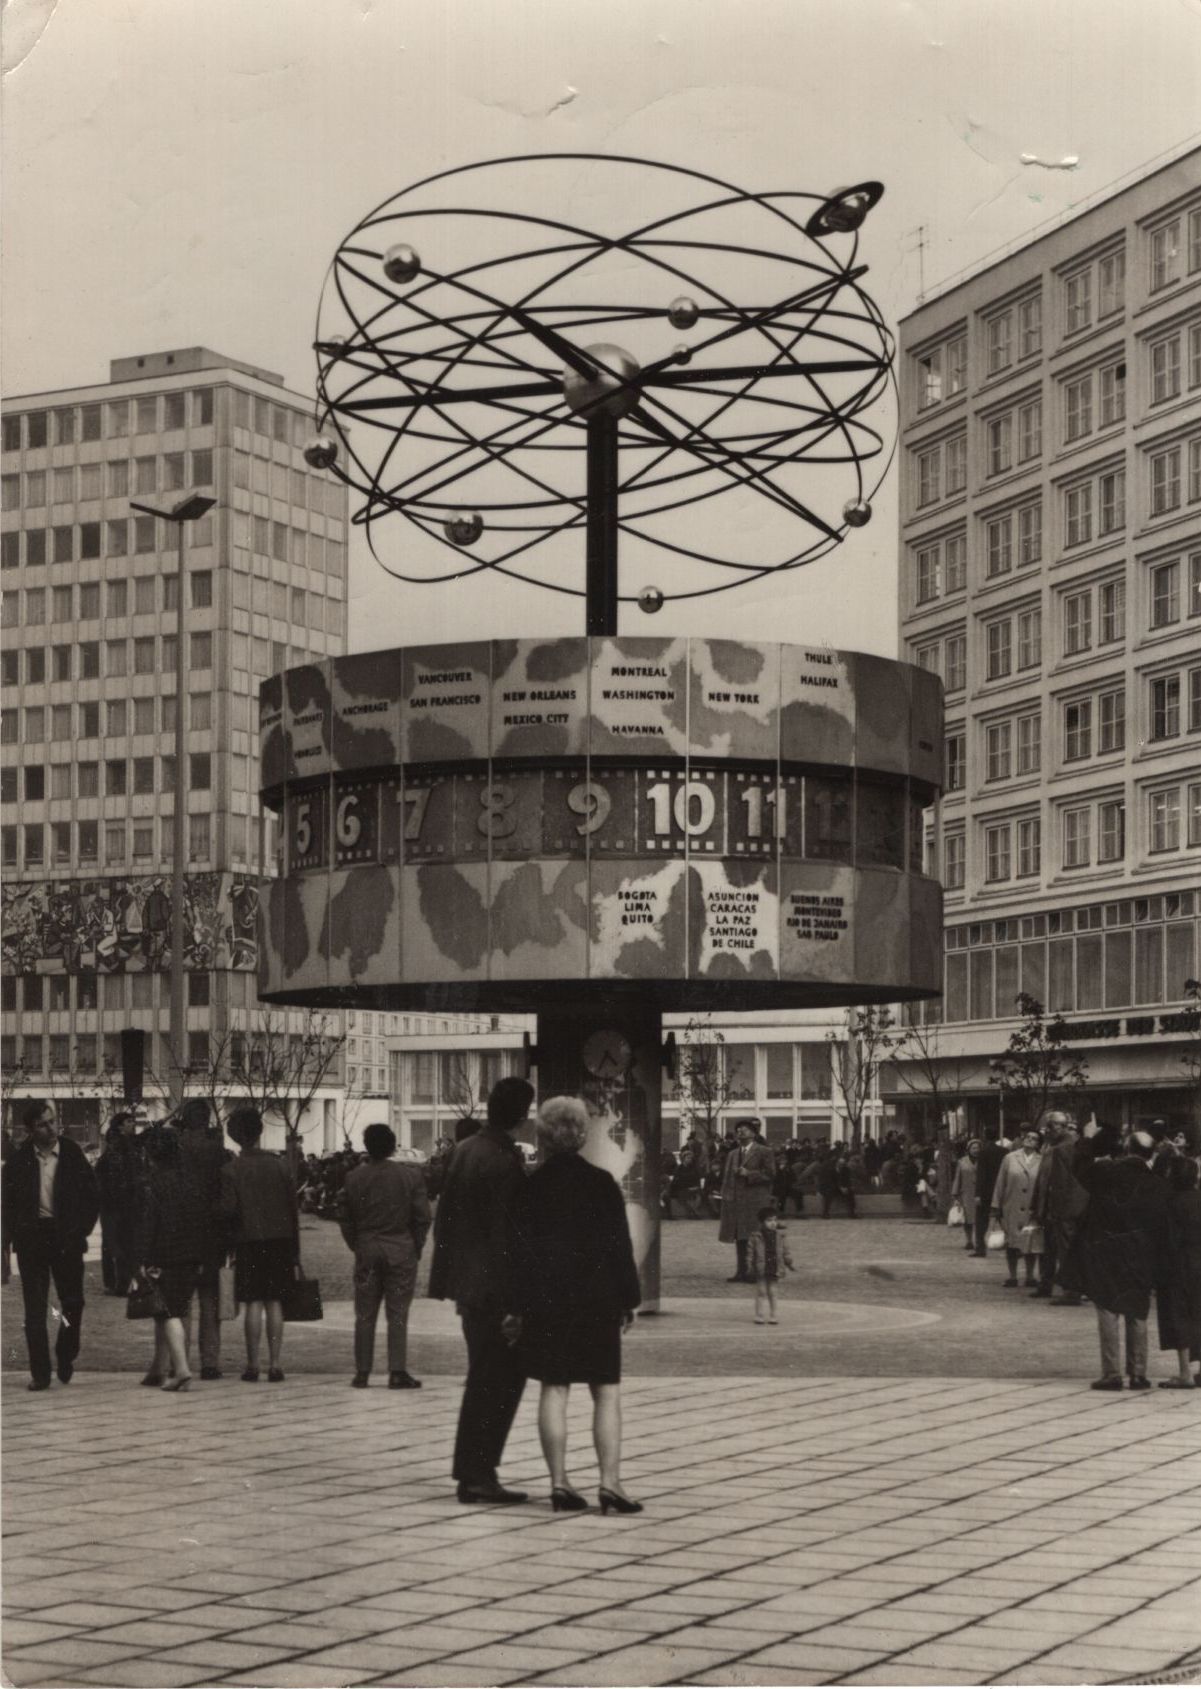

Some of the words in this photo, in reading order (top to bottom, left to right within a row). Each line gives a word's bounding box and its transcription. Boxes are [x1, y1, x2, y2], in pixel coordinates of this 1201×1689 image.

[805, 652, 832, 665] THULE
[418, 672, 472, 684] VANCOUVER
[611, 667, 668, 677] MONTREAL
[800, 675, 838, 688] HALIFAX
[410, 698, 428, 708] SAN
[430, 694, 481, 706] FRANCISCO
[503, 692, 526, 702] NEW
[530, 690, 576, 701] ORLEANS
[602, 690, 674, 700] WASHINGTON
[708, 692, 731, 703] NEW
[734, 693, 760, 704] YORK
[342, 702, 388, 715] ANCHORAGE
[504, 714, 542, 726] MEXICO
[546, 714, 569, 724] CITY
[612, 725, 664, 735] HAVANNA
[396, 788, 432, 840] 7
[477, 783, 517, 838] 8
[567, 782, 612, 836] 9
[646, 782, 716, 836] 10
[741, 786, 786, 840] 11
[336, 794, 362, 848] 6
[296, 803, 312, 855] 5
[618, 891, 657, 900] BOGOTA
[708, 892, 760, 902] ASUNCION
[624, 902, 650, 912] LIMA
[710, 904, 756, 914] CARACAS
[622, 914, 654, 926] QUITO
[716, 916, 730, 925] LA
[733, 916, 751, 925] PAZ
[710, 927, 758, 937] SANTIAGO
[814, 930, 839, 942] PAULO
[712, 939, 724, 948] DE
[727, 939, 756, 948] CHILE
